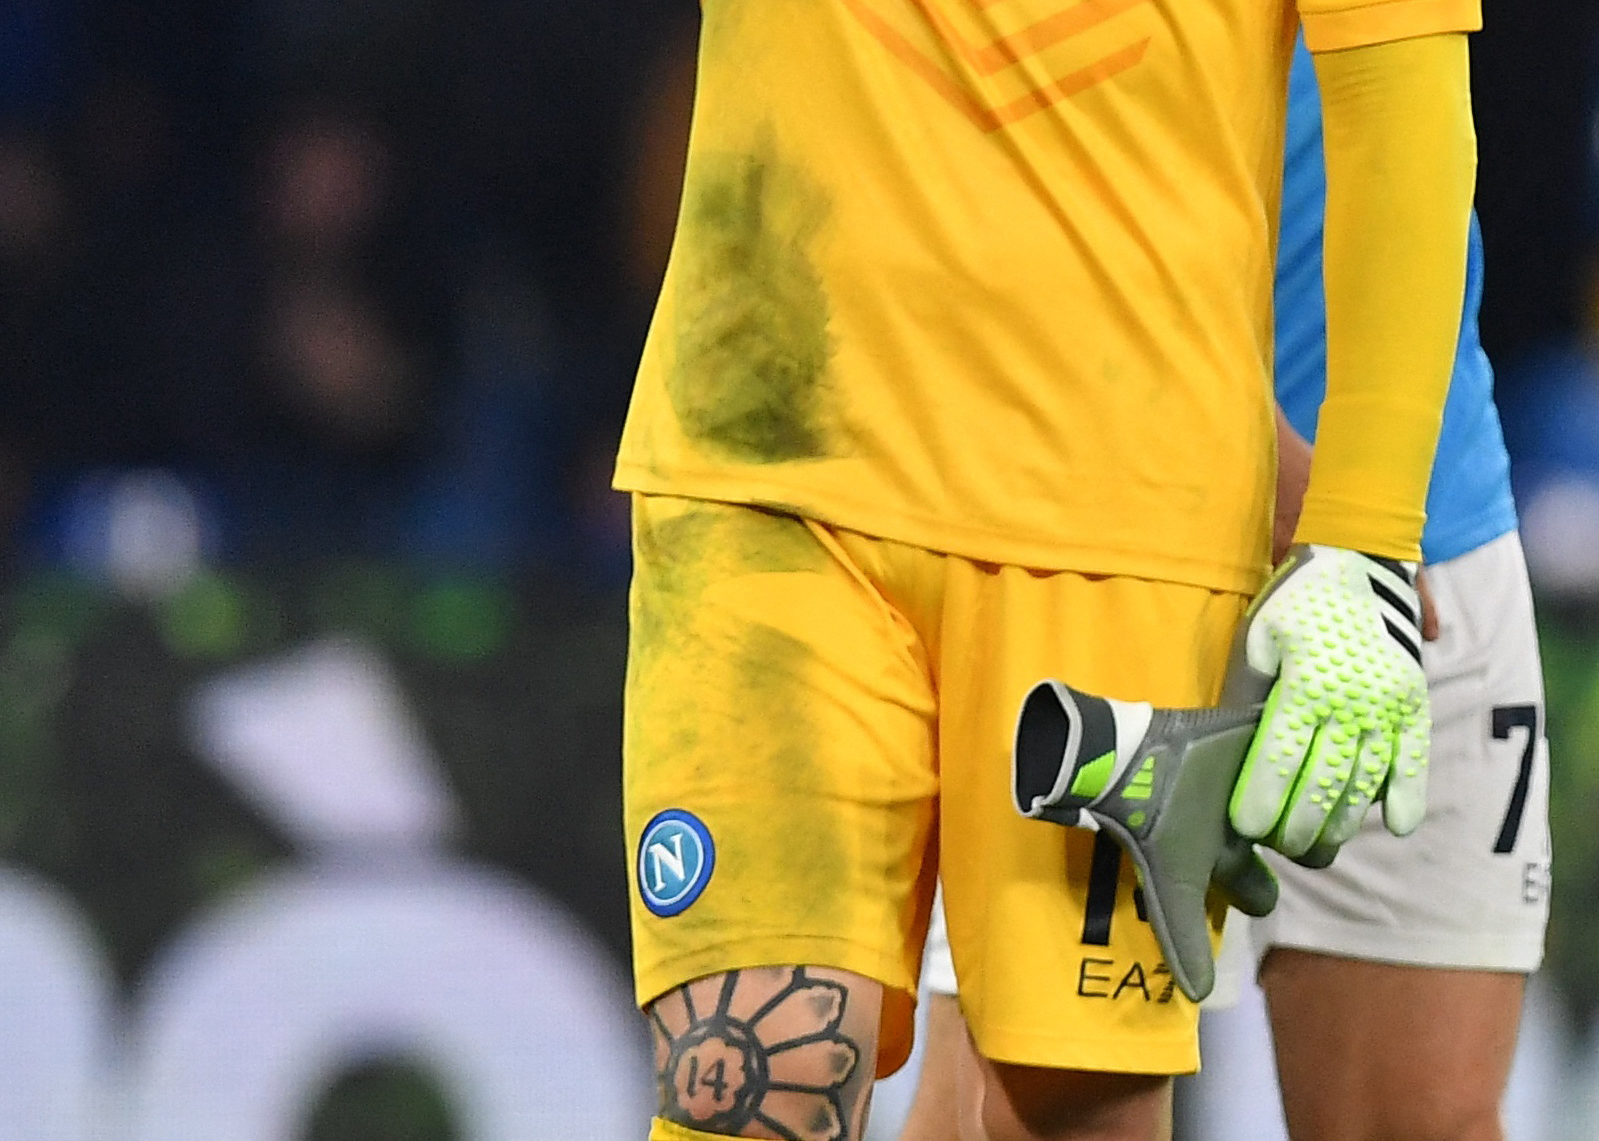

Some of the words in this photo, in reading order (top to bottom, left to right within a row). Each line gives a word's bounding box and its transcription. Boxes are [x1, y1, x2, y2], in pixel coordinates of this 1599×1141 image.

[1491, 705, 1537, 854] 7
[648, 833, 686, 893] N
[686, 1054, 728, 1103] 14
